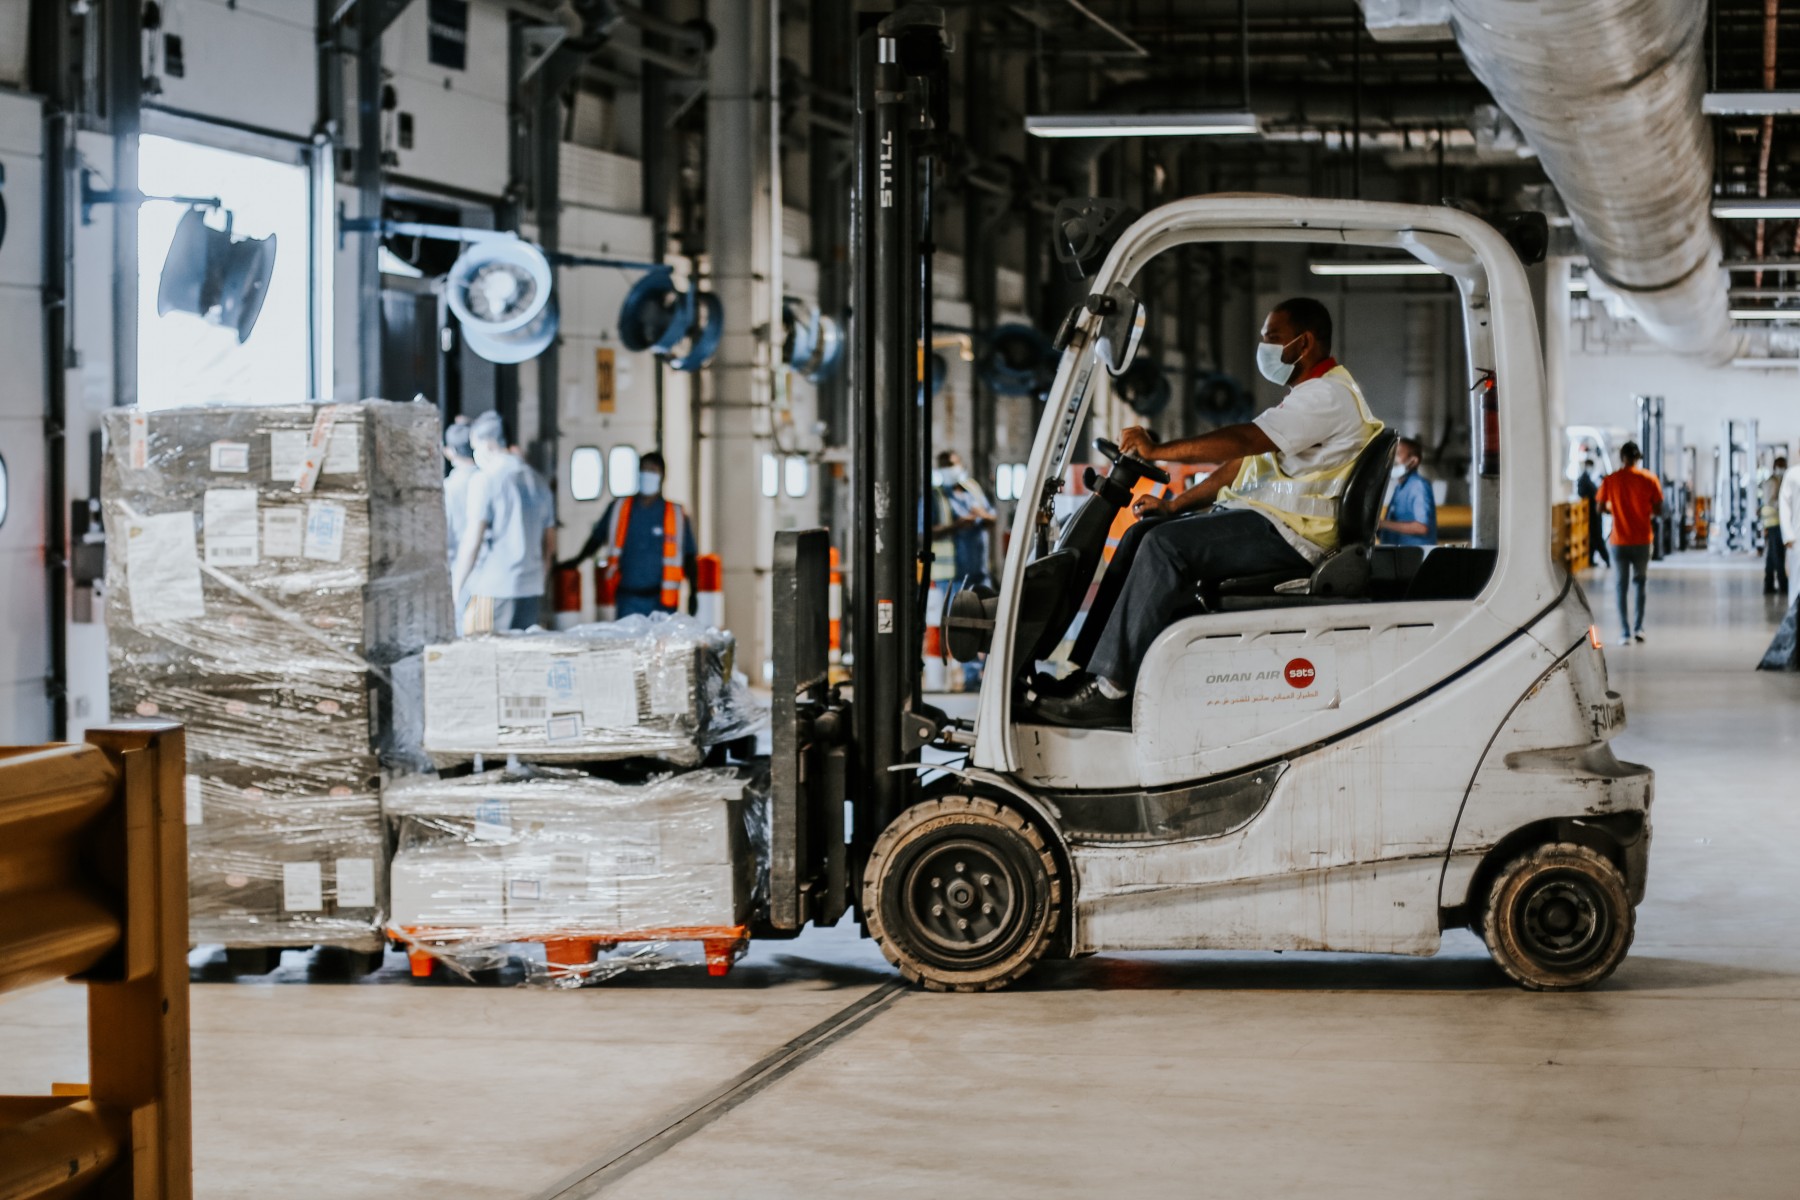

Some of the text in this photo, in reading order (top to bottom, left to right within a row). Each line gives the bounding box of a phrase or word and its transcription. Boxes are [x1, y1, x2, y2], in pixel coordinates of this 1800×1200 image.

[880, 131, 893, 207] STILL
[1206, 671, 1281, 684] OMAN AIR
[1289, 668, 1314, 678] sats
